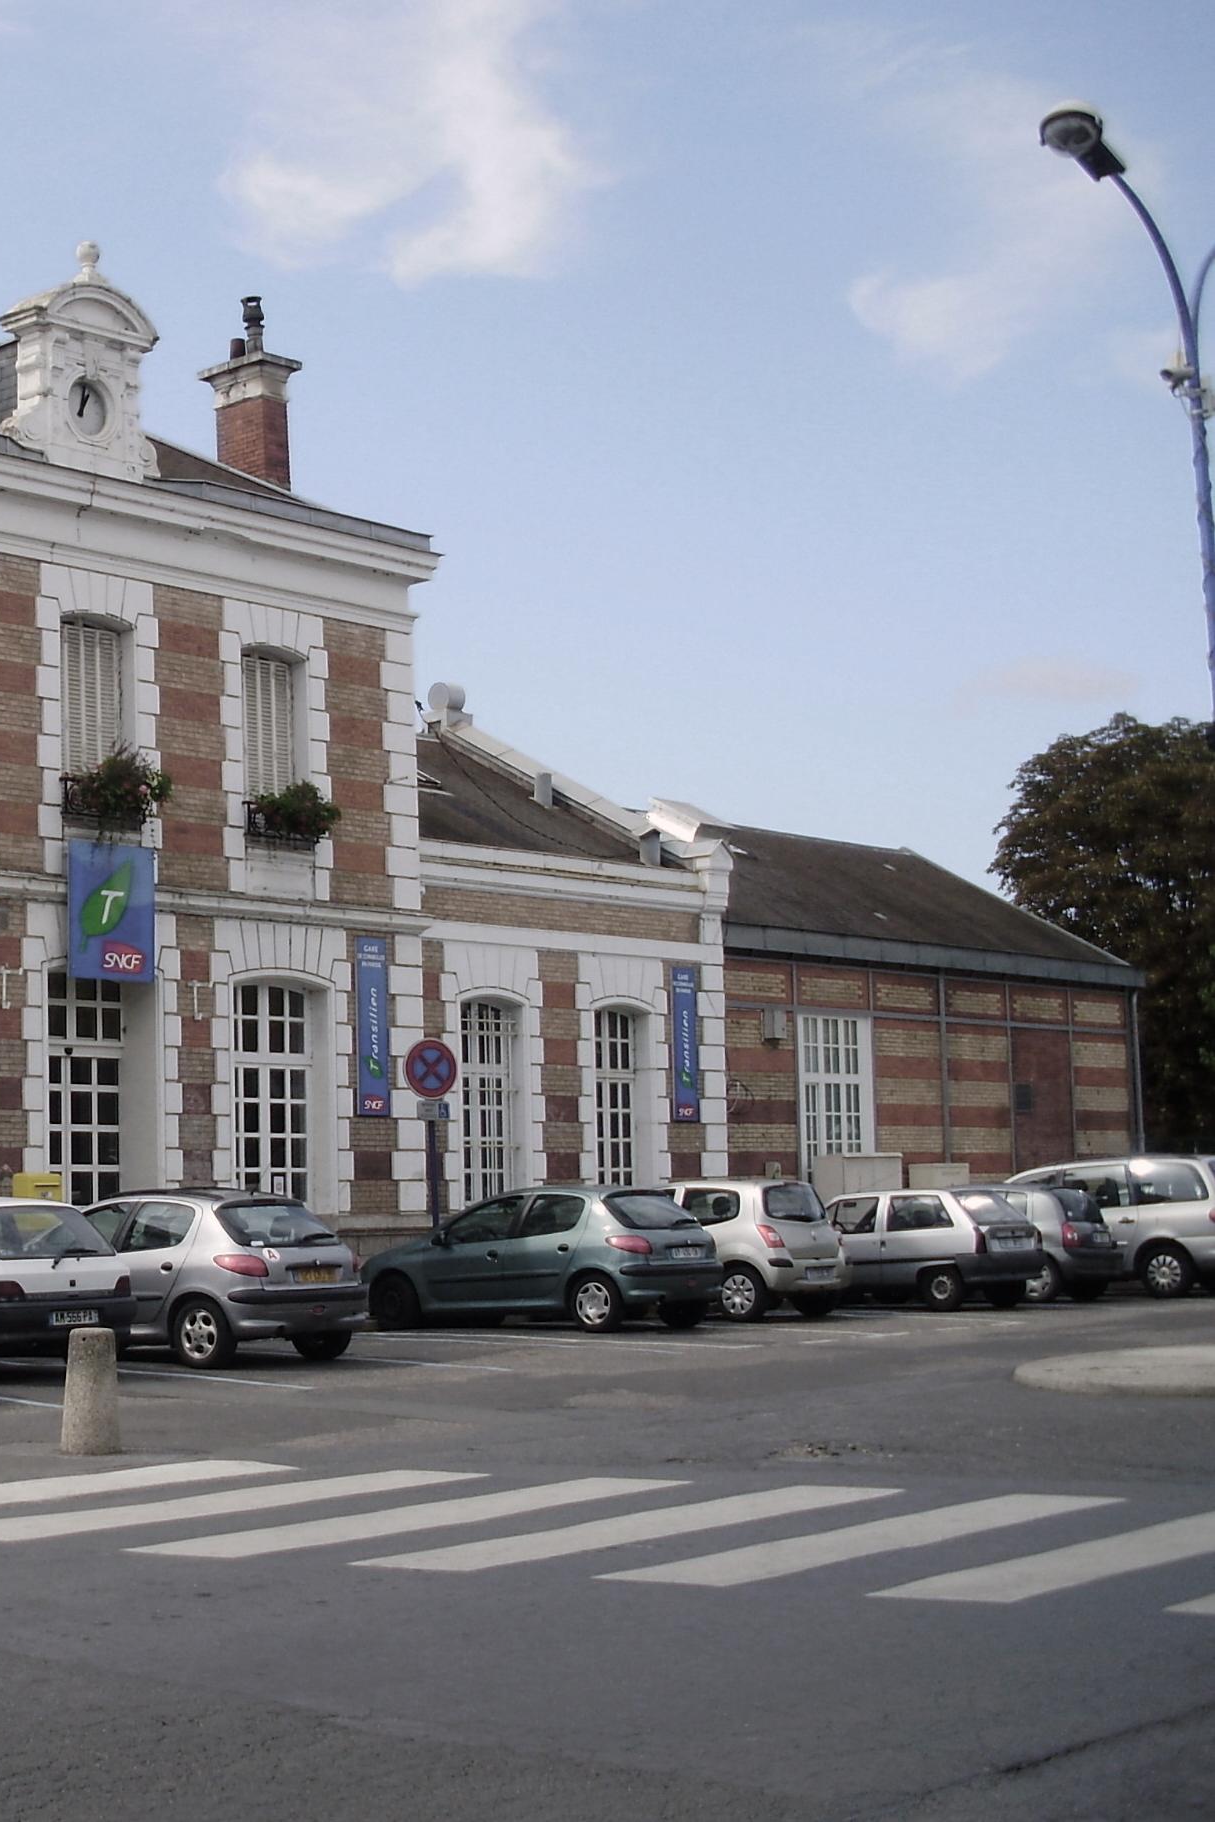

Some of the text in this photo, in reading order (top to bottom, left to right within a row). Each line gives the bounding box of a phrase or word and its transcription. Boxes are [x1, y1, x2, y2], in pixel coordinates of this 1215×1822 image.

[100, 889, 125, 925] T
[102, 952, 143, 970] SNCF
[369, 986, 379, 1070] Transilien
[364, 1099, 384, 1110] SNCF
[266, 1249, 278, 1260] A
